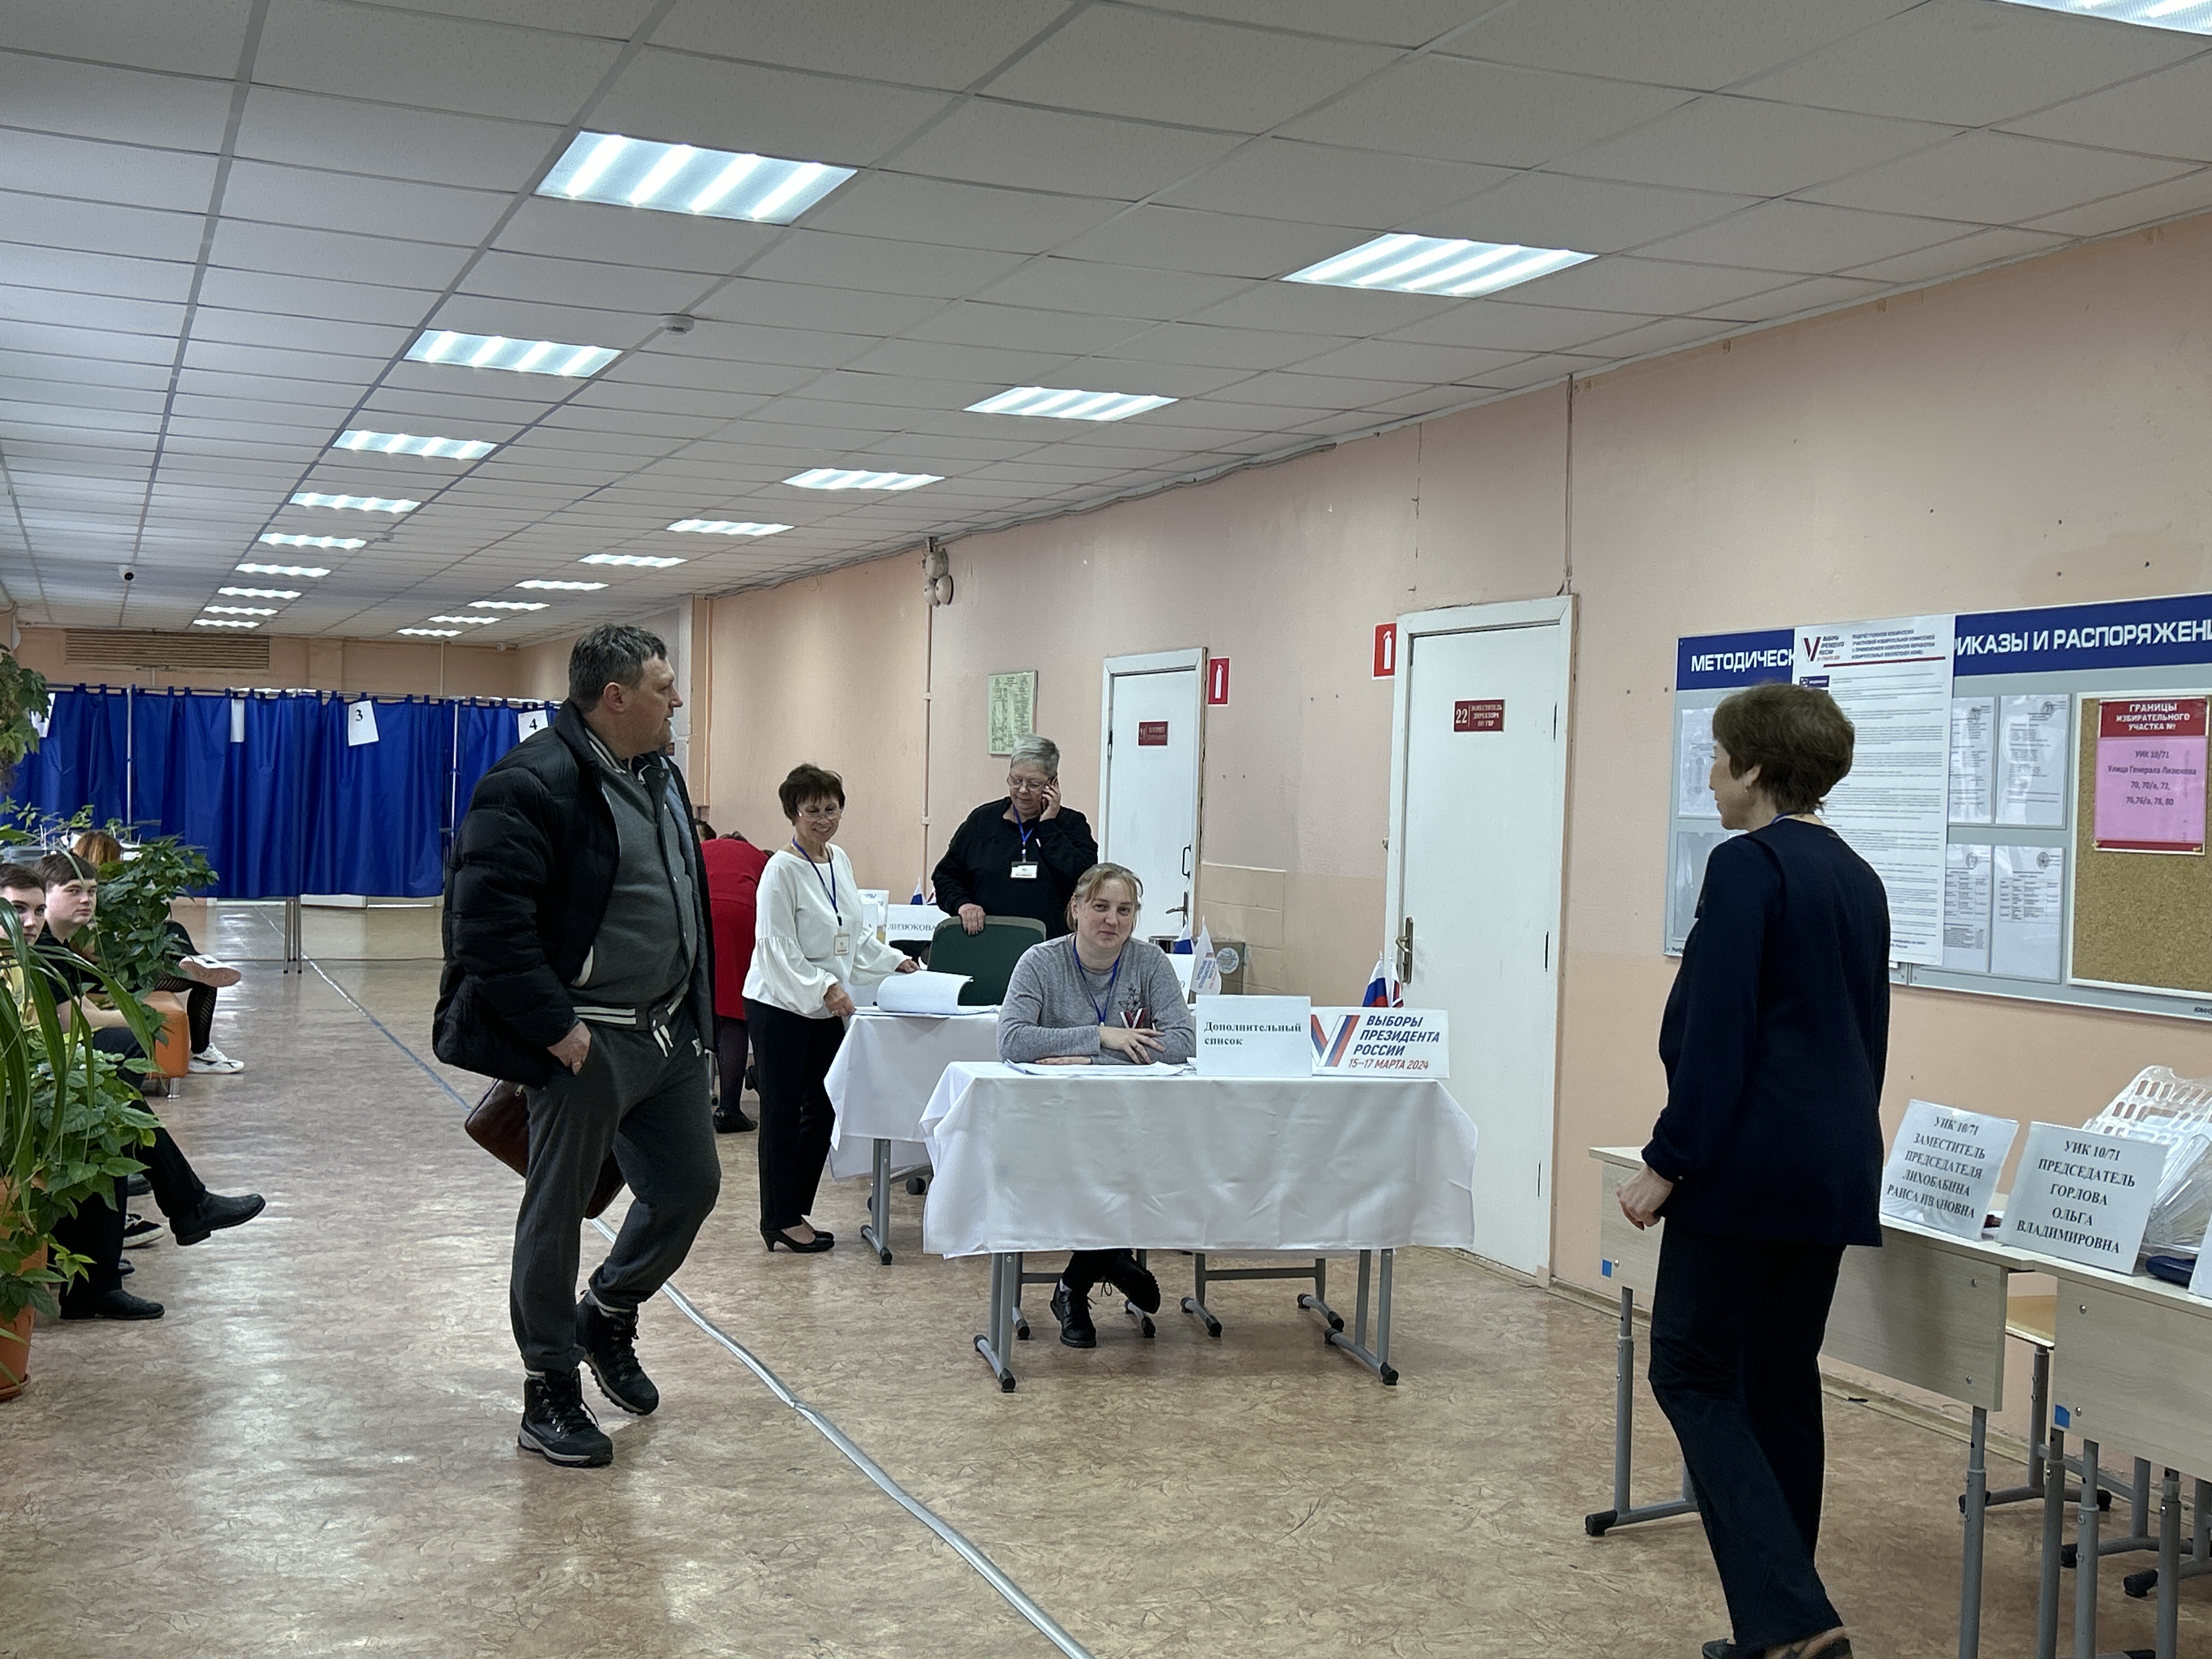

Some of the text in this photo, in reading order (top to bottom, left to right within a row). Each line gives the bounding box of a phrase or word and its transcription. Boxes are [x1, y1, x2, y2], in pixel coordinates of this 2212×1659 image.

[1955, 631, 2029, 656] ИКАЗЫ
[2033, 630, 2049, 651] И
[356, 709, 363, 721] 3
[1455, 708, 1468, 724] 22
[2129, 703, 2177, 713] ГРАНИЦЫ
[529, 718, 538, 730] 4
[2116, 713, 2191, 722] ИЗБИРАТЕЛЬНОГО
[1204, 1022, 1301, 1033] Дополнительный
[1366, 1015, 1424, 1028] ВЫБОРЫ
[1359, 1029, 1440, 1043] ПРЕЗИДЕНТА
[1353, 1044, 1406, 1056] РОССИИ
[1374, 1059, 1406, 1069] МАРТА
[1407, 1060, 1429, 1070] 2024
[1933, 1116, 1957, 1131] УИК
[1914, 1132, 1985, 1159] ЗАМЕСТИТЕЛЬ
[2064, 1140, 2120, 1161] УИК 10/71
[1905, 1150, 1983, 1179] ПРЕДСЕДАТЕЛЯ
[2038, 1158, 2135, 1187] ПРЕДСЕДАТЕЛЬ
[1902, 1169, 1971, 1197] ЛИХОБАБИНА
[1887, 1184, 1918, 1203] РАИСА
[2050, 1183, 2108, 1205] ГОРЛОВА
[2052, 1207, 2094, 1226] ОЛЬГА
[2016, 1220, 2120, 1254] ВЛАДИМИРОВНА
